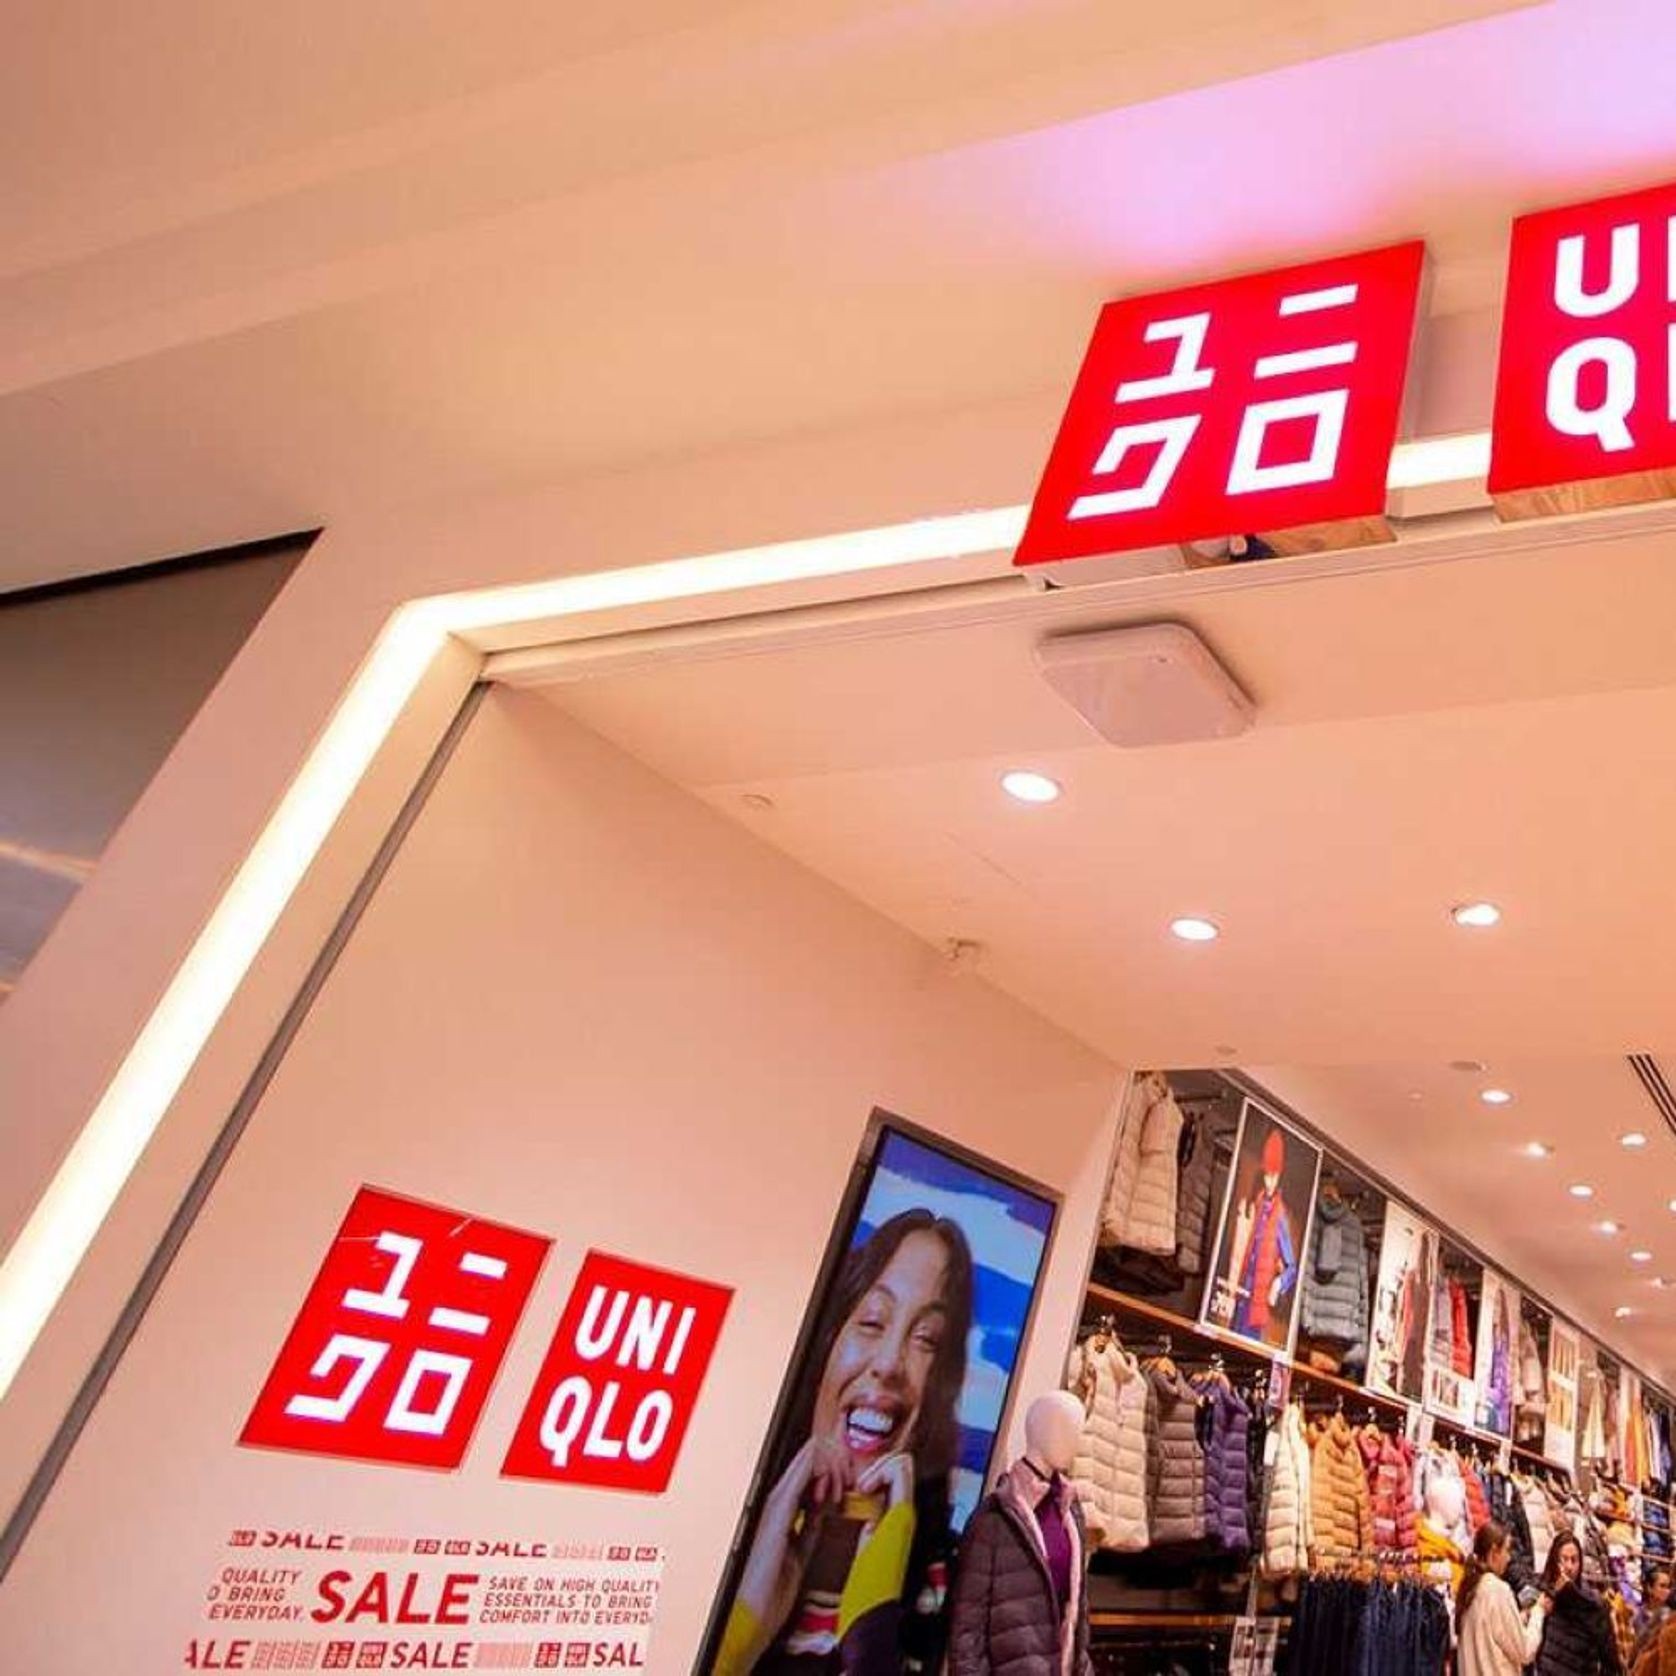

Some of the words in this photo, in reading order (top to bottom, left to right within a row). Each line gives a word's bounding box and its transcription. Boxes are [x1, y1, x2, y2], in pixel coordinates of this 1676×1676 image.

[1554, 216, 1676, 318] U
[1546, 323, 1676, 452] Q
[575, 1285, 696, 1375] UNI
[539, 1376, 673, 1467] QLO
[222, 1567, 302, 1585] QUALITY
[489, 1575, 528, 1592] SAVE
[534, 1577, 555, 1592] ON
[560, 1577, 596, 1593] HIGH
[228, 1586, 286, 1602] BRING
[310, 1570, 479, 1624] SALE
[484, 1592, 576, 1609] ESSENTIALS
[582, 1594, 601, 1609] TO
[608, 1595, 653, 1610] BRING
[479, 1609, 550, 1625] COMFORT
[556, 1609, 588, 1625] INTO
[389, 1641, 474, 1669] SALE
